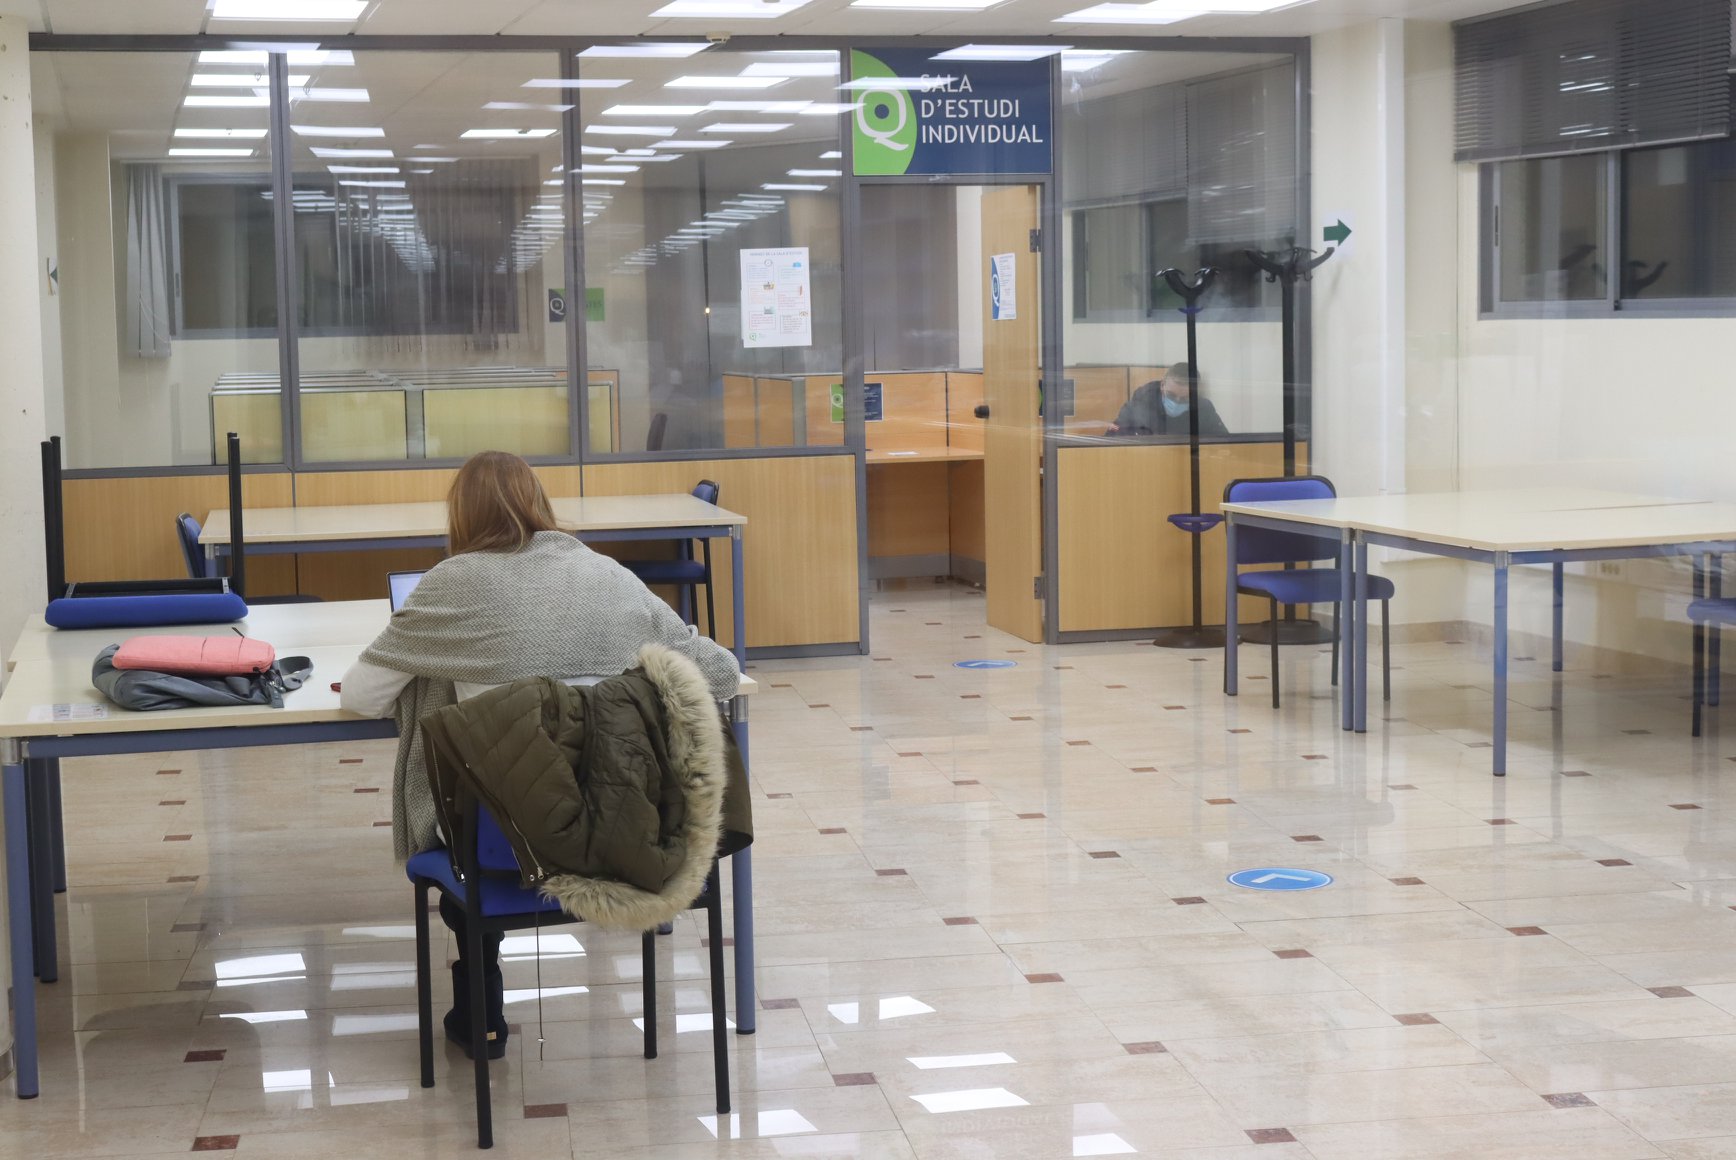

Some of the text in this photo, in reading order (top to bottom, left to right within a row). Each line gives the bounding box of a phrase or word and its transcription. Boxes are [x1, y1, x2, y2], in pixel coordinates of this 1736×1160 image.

[920, 74, 973, 93] SALA
[921, 98, 1020, 119] D'ESTUDI
[922, 124, 1044, 144] INDIVIDUAL
